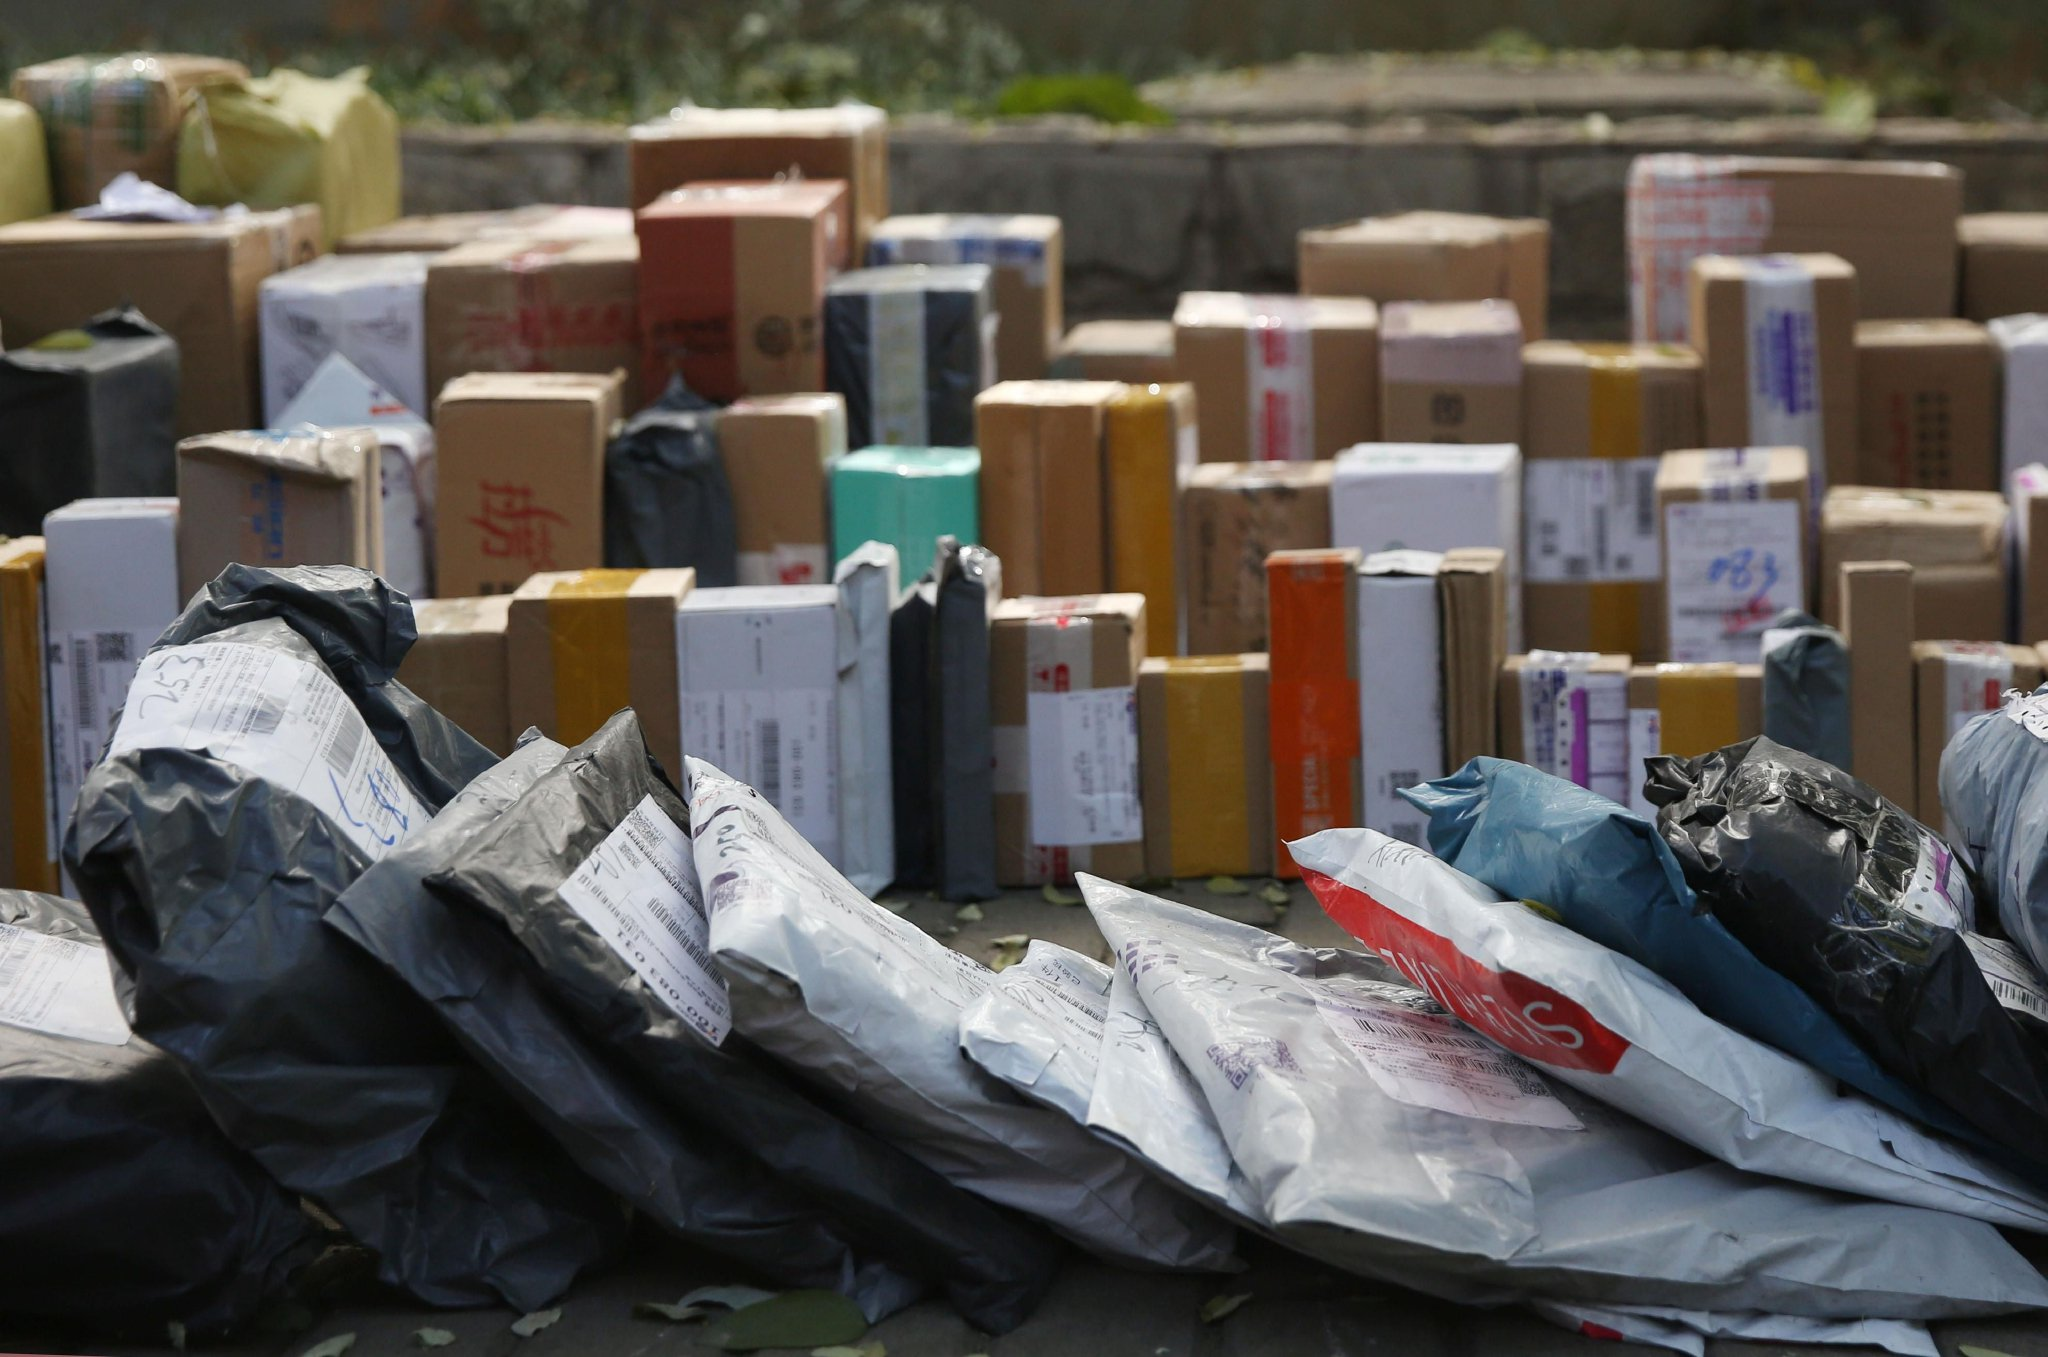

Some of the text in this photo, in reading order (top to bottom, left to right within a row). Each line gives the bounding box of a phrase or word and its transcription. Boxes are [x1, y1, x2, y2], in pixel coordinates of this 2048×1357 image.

[138, 654, 206, 720] 253
[616, 927, 646, 964] 031
[649, 967, 721, 1038] 100-083
